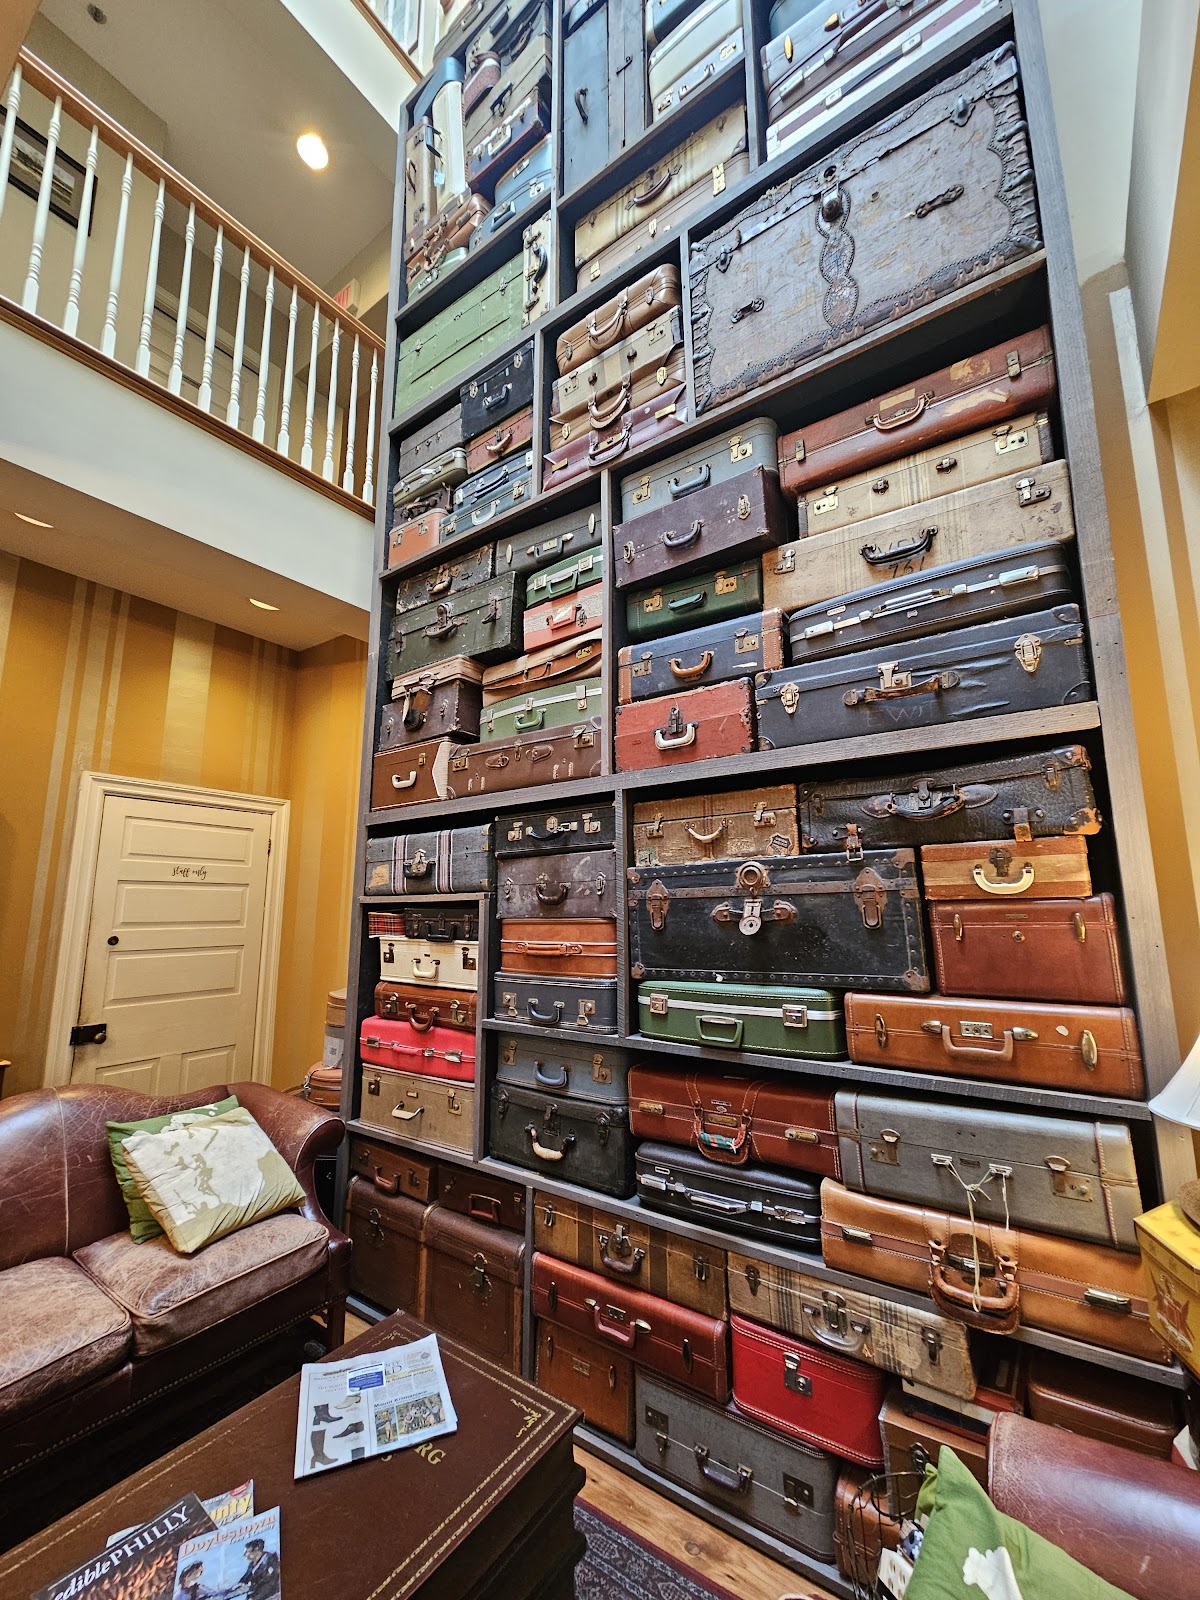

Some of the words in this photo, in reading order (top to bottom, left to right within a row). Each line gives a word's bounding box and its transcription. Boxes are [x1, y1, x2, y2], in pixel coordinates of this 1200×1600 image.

[172, 866, 190, 877] staff
[192, 866, 207, 880] only
[414, 1442, 446, 1464] RG
[181, 1514, 275, 1556] Doylestown
